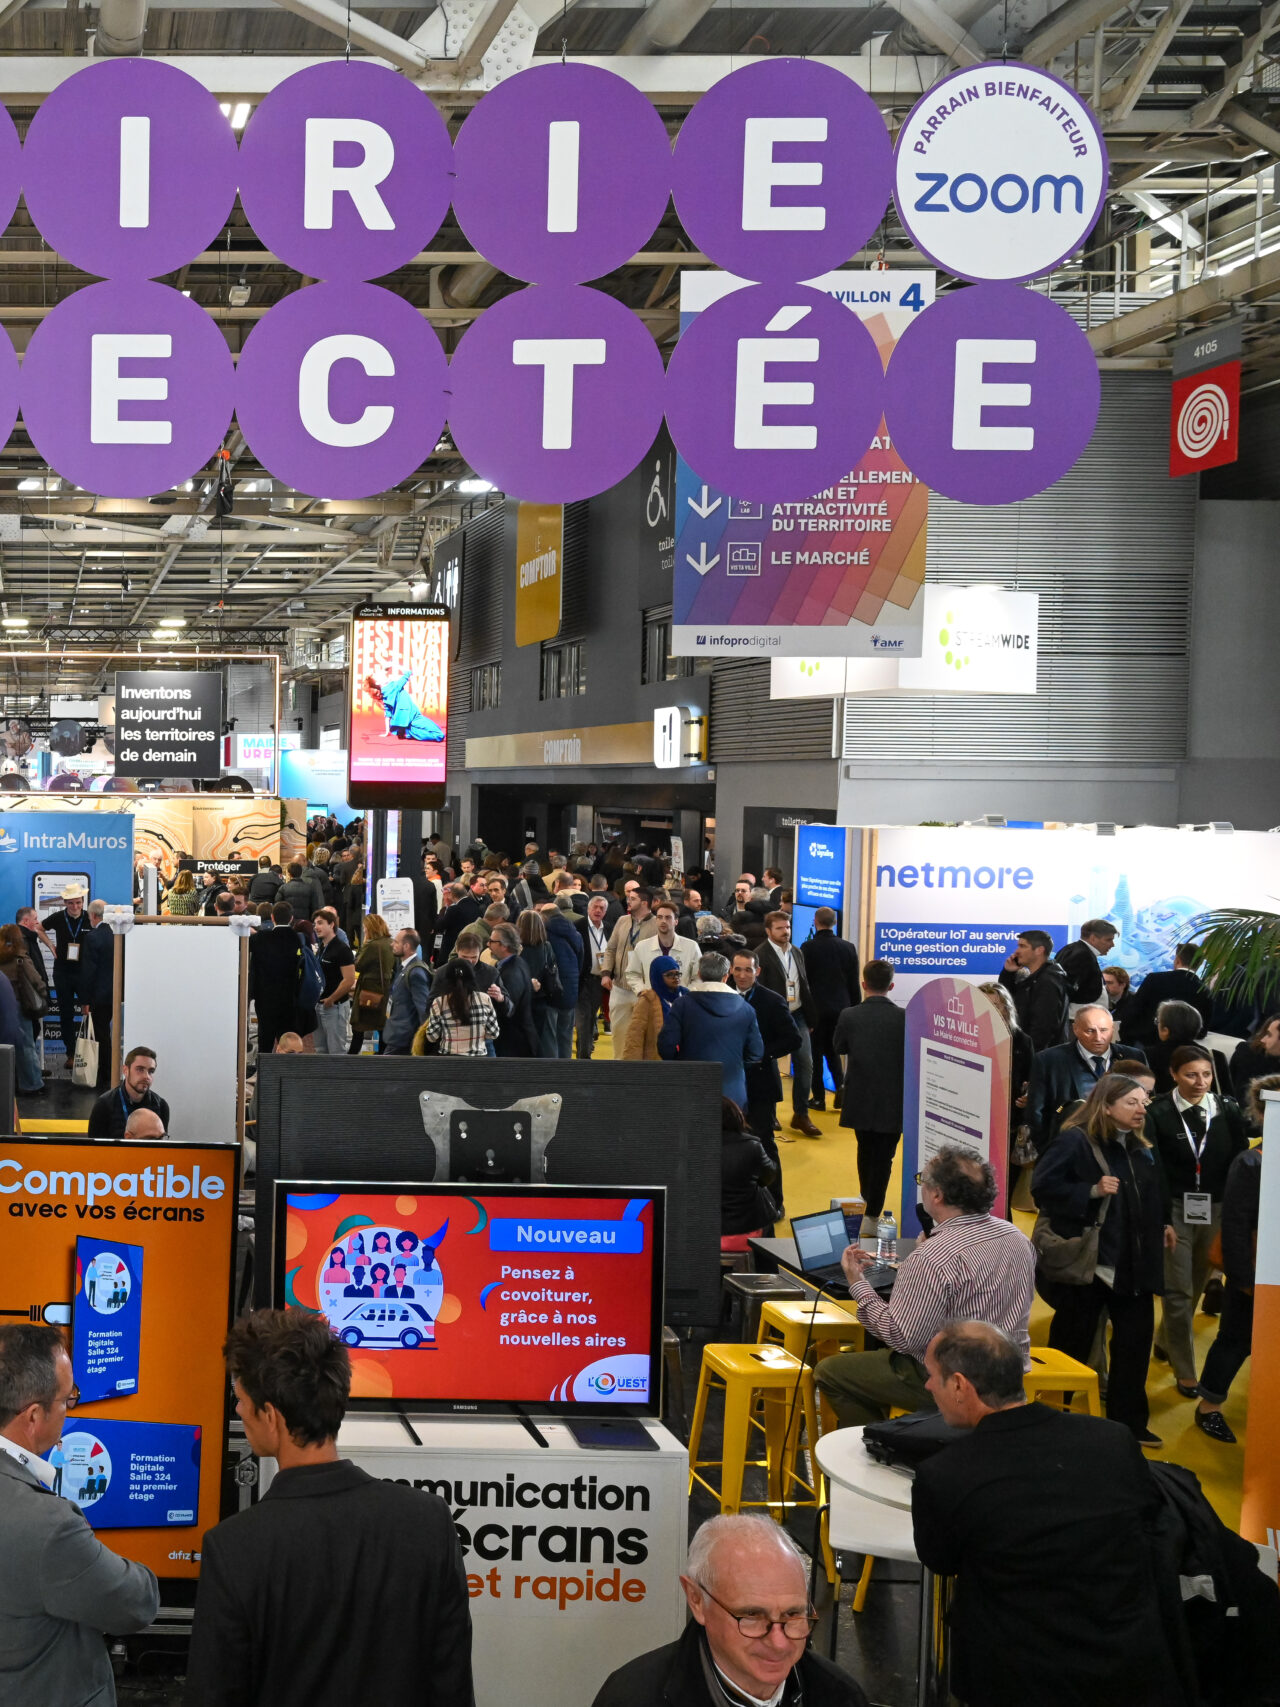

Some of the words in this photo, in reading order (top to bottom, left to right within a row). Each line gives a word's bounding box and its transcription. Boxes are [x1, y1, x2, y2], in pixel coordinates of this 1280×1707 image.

[913, 85, 980, 155] PARRAIN
[984, 81, 1088, 159] BIENFAITEUR
[913, 172, 1084, 214] zoom
[827, 290, 891, 303] AVILLON
[899, 283, 925, 312] 4
[1193, 340, 1218, 358] 4105
[837, 488, 857, 499] ET
[772, 500, 888, 515] ATTRACTIVITÉ
[772, 520, 794, 532] DU
[798, 520, 892, 532] TERRITOIRE
[658, 537, 674, 552] toile
[771, 552, 792, 565] LE
[796, 548, 870, 565] MARCHÉ
[387, 608, 445, 616] INFORMATIONS
[955, 631, 1030, 650] STEAMWIDE
[121, 685, 191, 700] Inventons
[121, 707, 202, 724] aujourd'hui
[121, 727, 141, 741] les
[145, 728, 215, 741] territoires
[121, 748, 139, 761] de
[142, 748, 197, 762] demain
[23, 831, 127, 849] IntraMuros
[197, 862, 241, 873] Protéger
[875, 862, 1034, 890] netmore
[880, 927, 948, 942] L'Opérateur
[950, 928, 967, 941] IoT
[969, 932, 983, 941] au
[986, 929, 1021, 941] servic
[880, 941, 913, 953] d'une
[915, 941, 960, 956] gestion
[962, 942, 1006, 954] durable
[880, 955, 899, 966] des
[902, 957, 967, 966] ressources
[933, 1013, 946, 1028] VIS
[946, 1017, 957, 1030] TA
[958, 1020, 980, 1038] VILLE
[933, 1029, 940, 1037] La
[940, 1031, 953, 1041] Mairie
[953, 1035, 978, 1048] connectée
[8, 1202, 68, 1218] avec
[75, 1204, 116, 1219] vos
[123, 1200, 205, 1222] écrans
[516, 1224, 616, 1245] Nouveau
[501, 1265, 560, 1281] Pensez
[564, 1264, 575, 1281] à
[500, 1287, 593, 1306] covoiturer,
[499, 1308, 548, 1326] grâce
[552, 1309, 563, 1324] à
[566, 1312, 597, 1325] nos
[88, 1330, 123, 1339] Formation
[499, 1331, 580, 1347] nouvelles
[584, 1333, 627, 1348] aires
[87, 1338, 114, 1348] Digitale
[87, 1347, 105, 1356] Salle
[106, 1346, 119, 1355] 324
[87, 1357, 96, 1365] au
[97, 1354, 124, 1367] premier
[86, 1365, 107, 1375] étage
[130, 1453, 176, 1463] Formation
[130, 1463, 165, 1473] Digitale
[129, 1472, 153, 1481] Salle
[154, 1472, 171, 1481] 324
[129, 1482, 141, 1491] au
[142, 1482, 178, 1493] premier
[129, 1491, 155, 1501] étage
[453, 1508, 648, 1565] écrans
[467, 1566, 501, 1599] et
[514, 1568, 647, 1610] rapide
